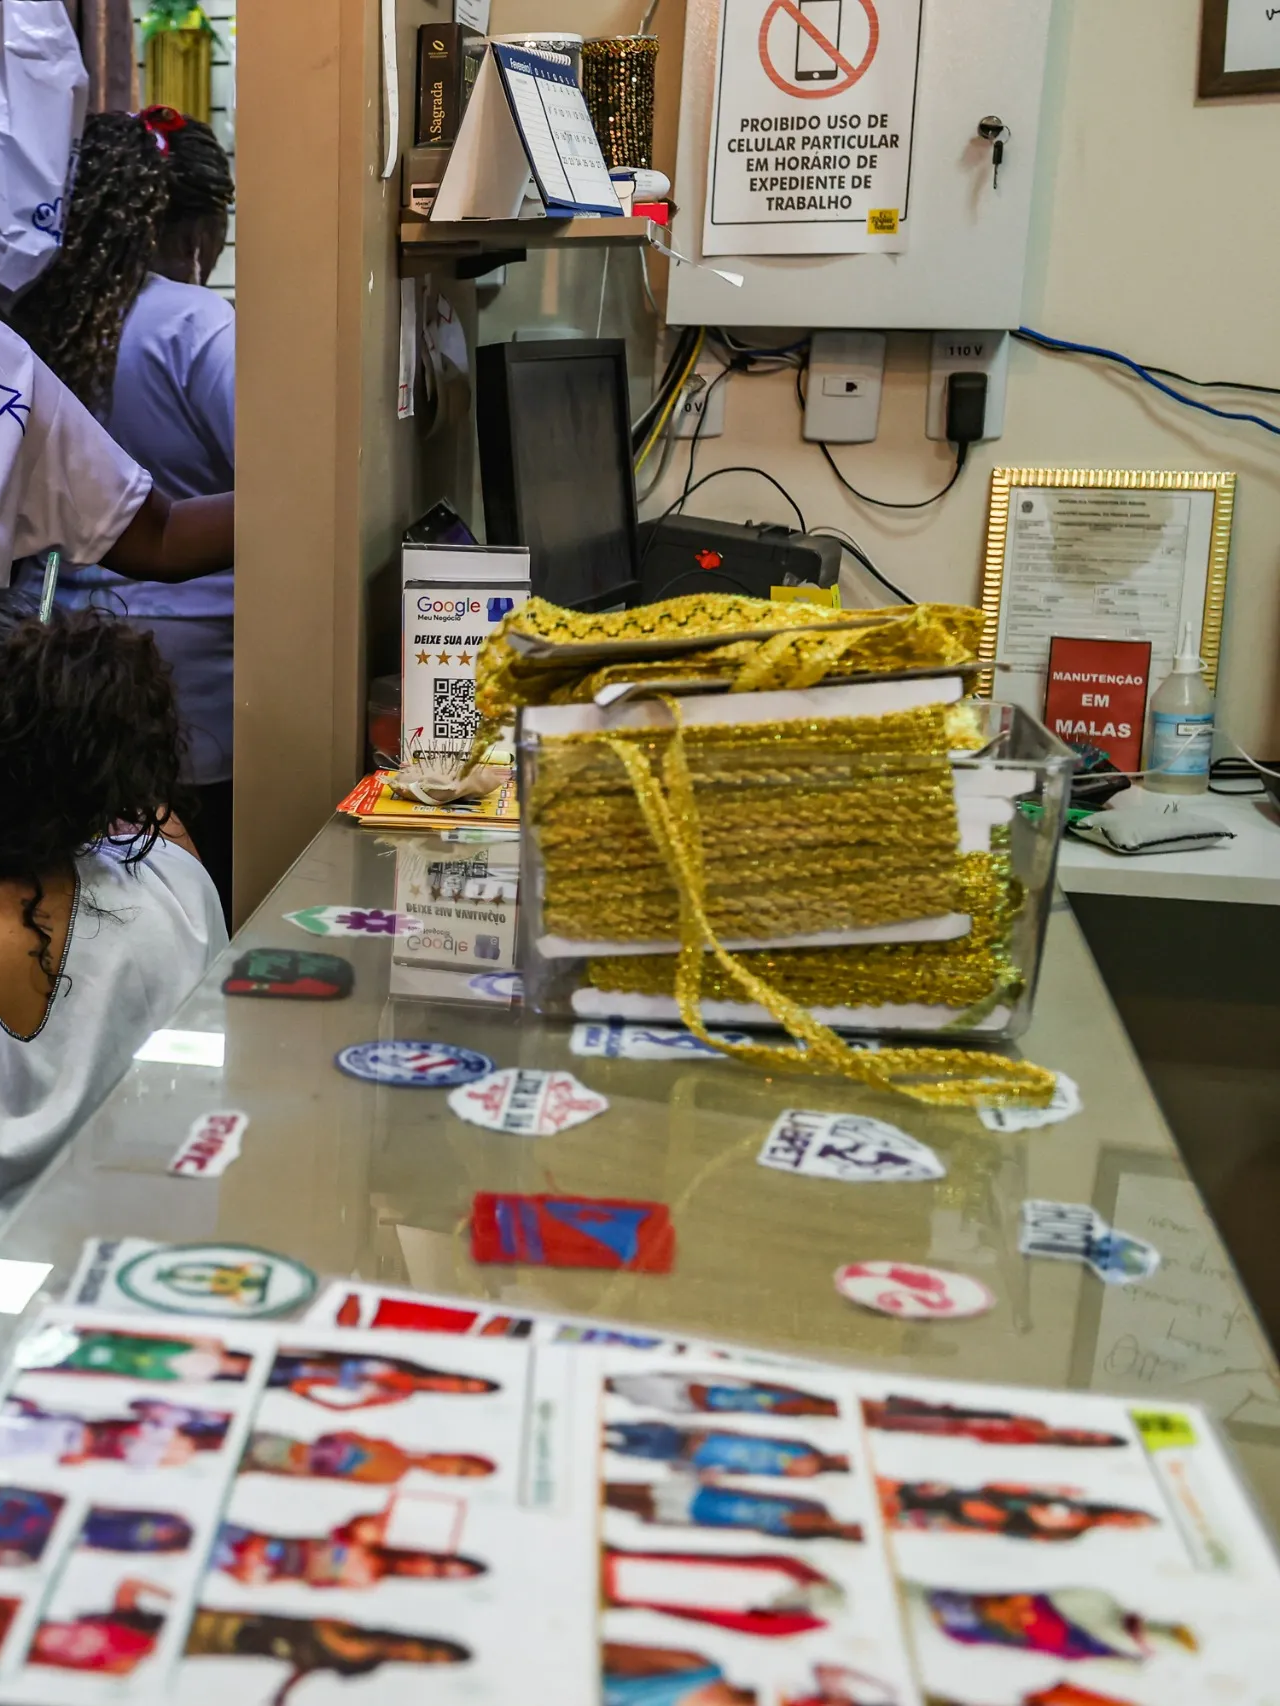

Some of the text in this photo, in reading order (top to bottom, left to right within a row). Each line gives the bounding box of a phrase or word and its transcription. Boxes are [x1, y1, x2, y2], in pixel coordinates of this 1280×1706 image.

[430, 81, 445, 133] Sagrada
[740, 113, 889, 133] PROIBIDO USO DE
[727, 134, 900, 153] CELULAR PARTICULAR
[746, 151, 878, 172] EM HORÁRIO DE
[749, 174, 872, 192] EXPEDIENTE DE
[765, 195, 852, 212] TRABALHO
[949, 345, 983, 356] 110 V
[417, 596, 481, 617] Google
[433, 612, 462, 623] Negócio
[414, 634, 442, 645] DEIXE
[443, 635, 462, 645] SUA
[1052, 670, 1143, 687] MANUTENÇÃO
[1081, 693, 1110, 708] EM
[1055, 719, 1132, 739] MALAS
